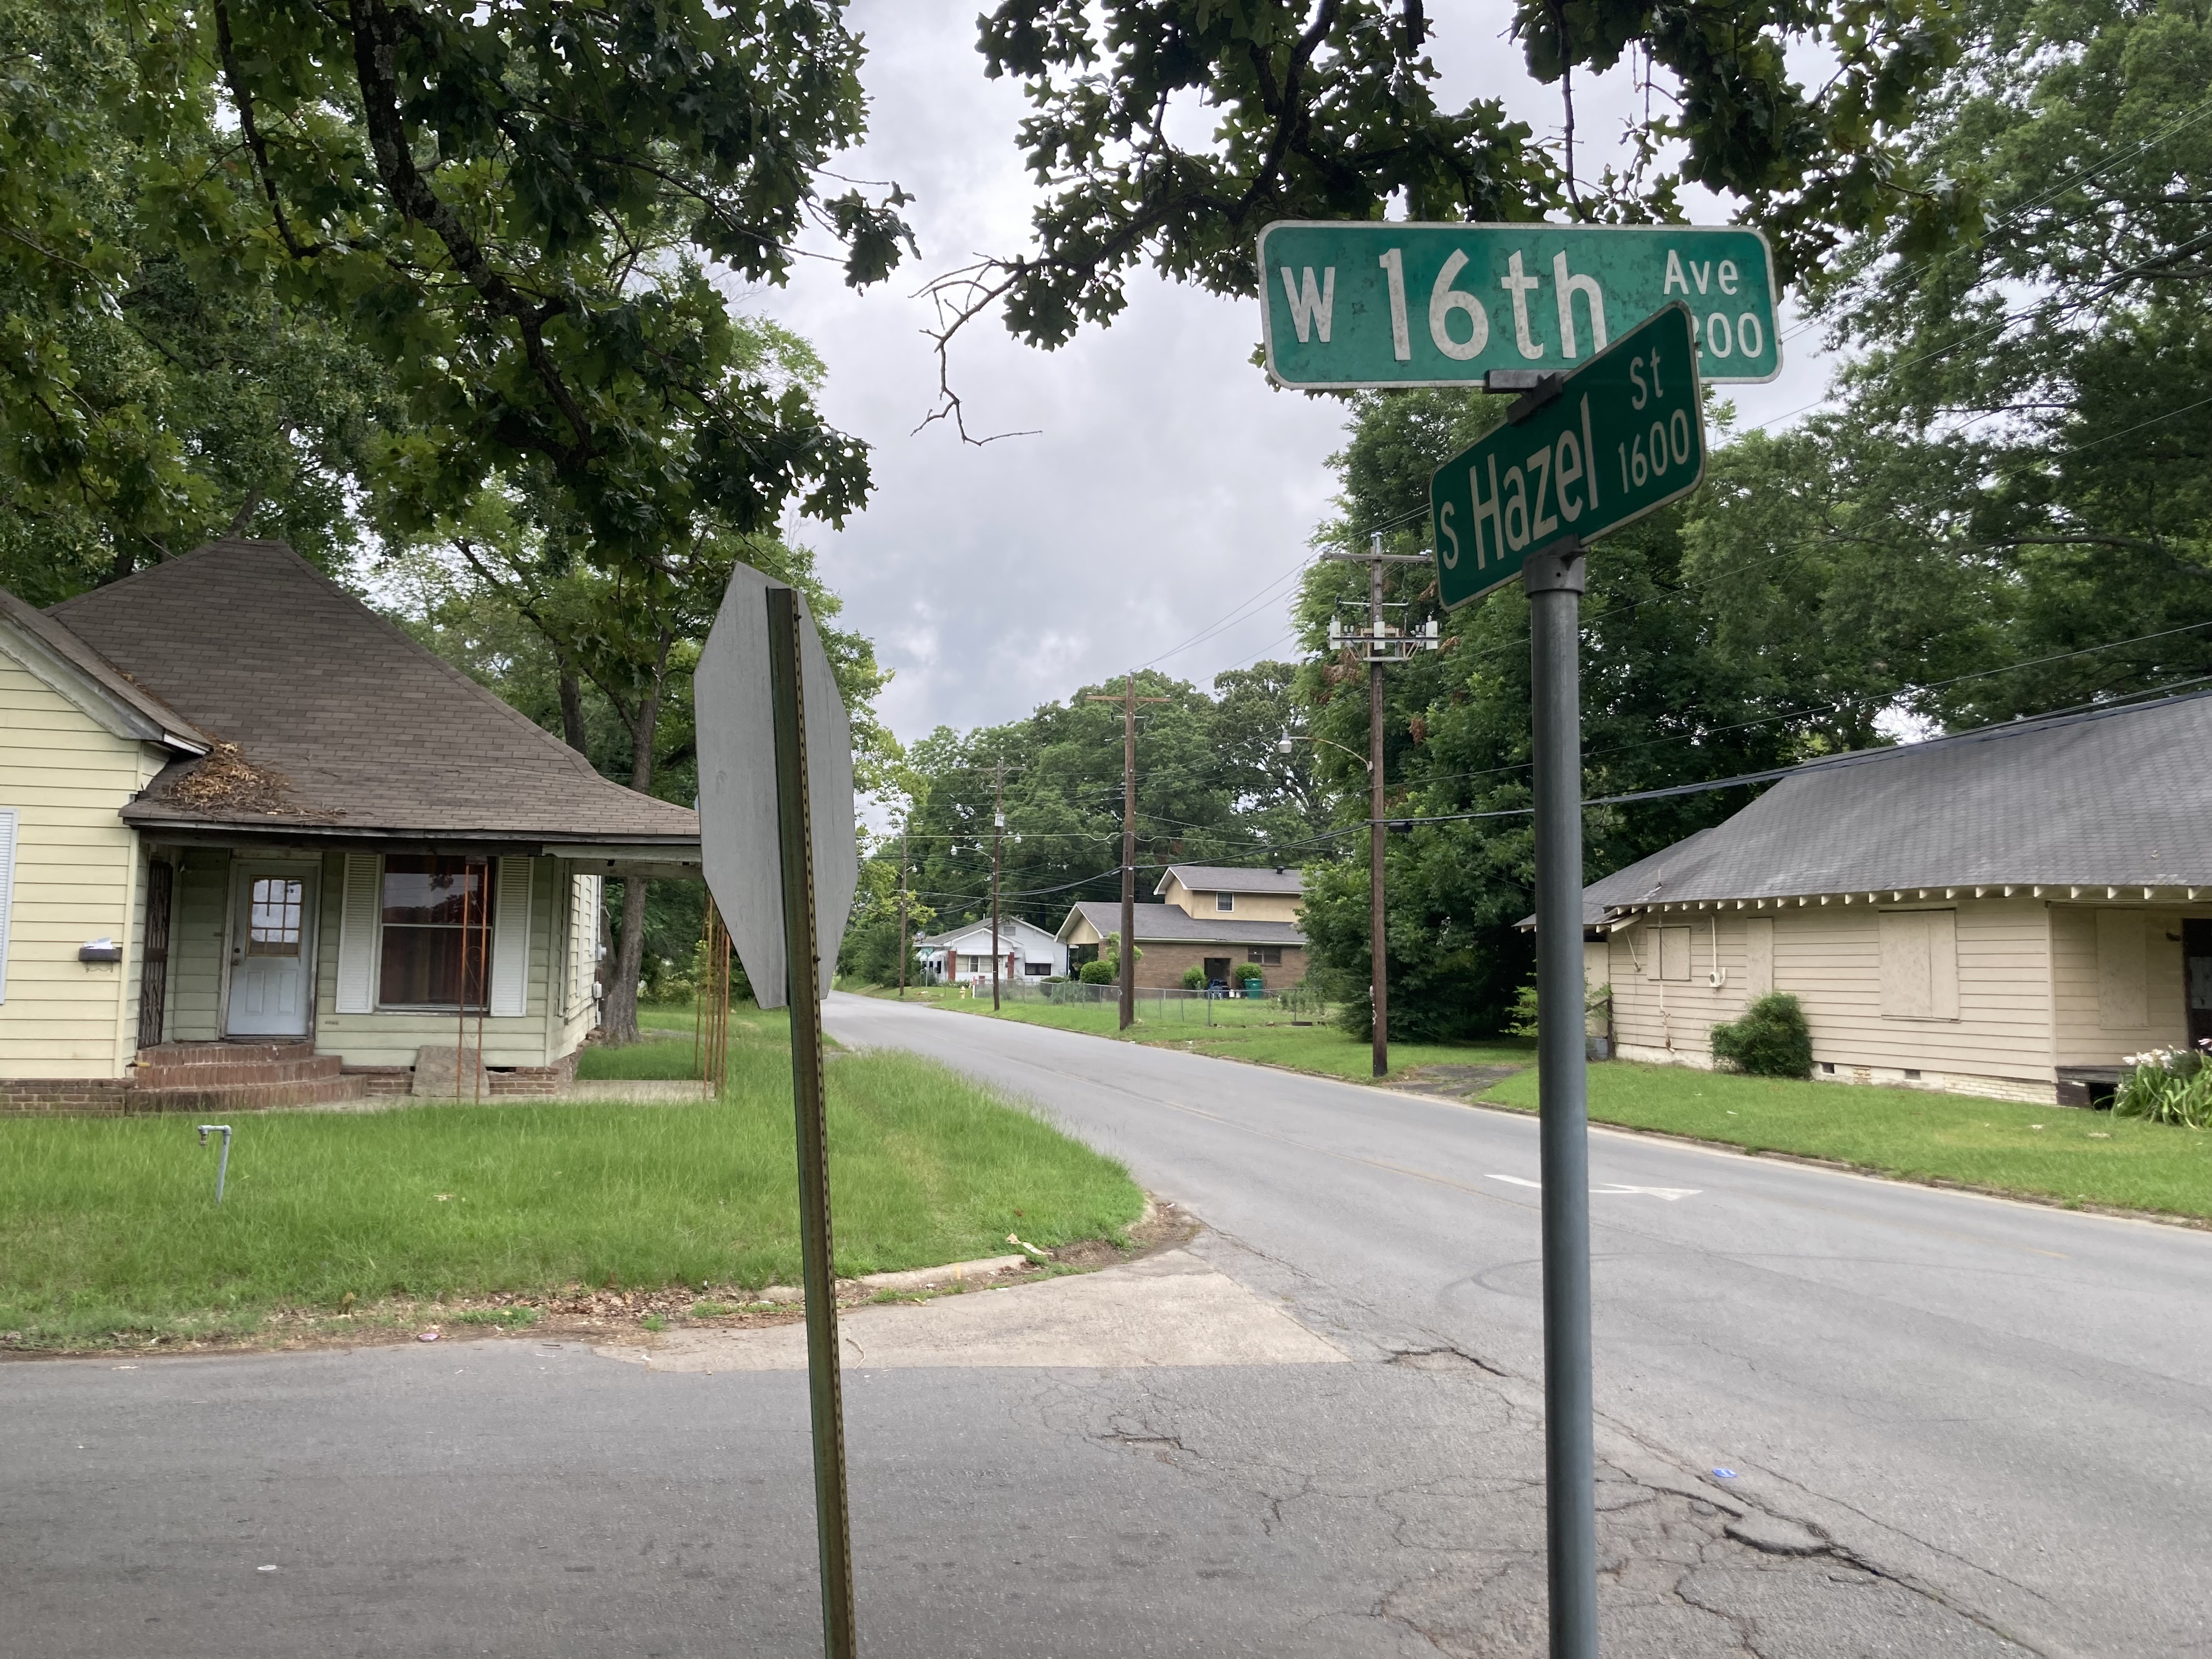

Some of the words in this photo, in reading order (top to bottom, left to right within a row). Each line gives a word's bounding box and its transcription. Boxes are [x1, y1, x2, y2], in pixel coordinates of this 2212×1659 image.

[1280, 267, 1335, 343] W
[1379, 248, 1607, 360] 16th
[1663, 250, 1738, 295] Ave
[1440, 500, 1458, 569] S
[1470, 392, 1599, 571] Hazel
[1629, 346, 1663, 410] St
[1618, 408, 1689, 494] 1600
